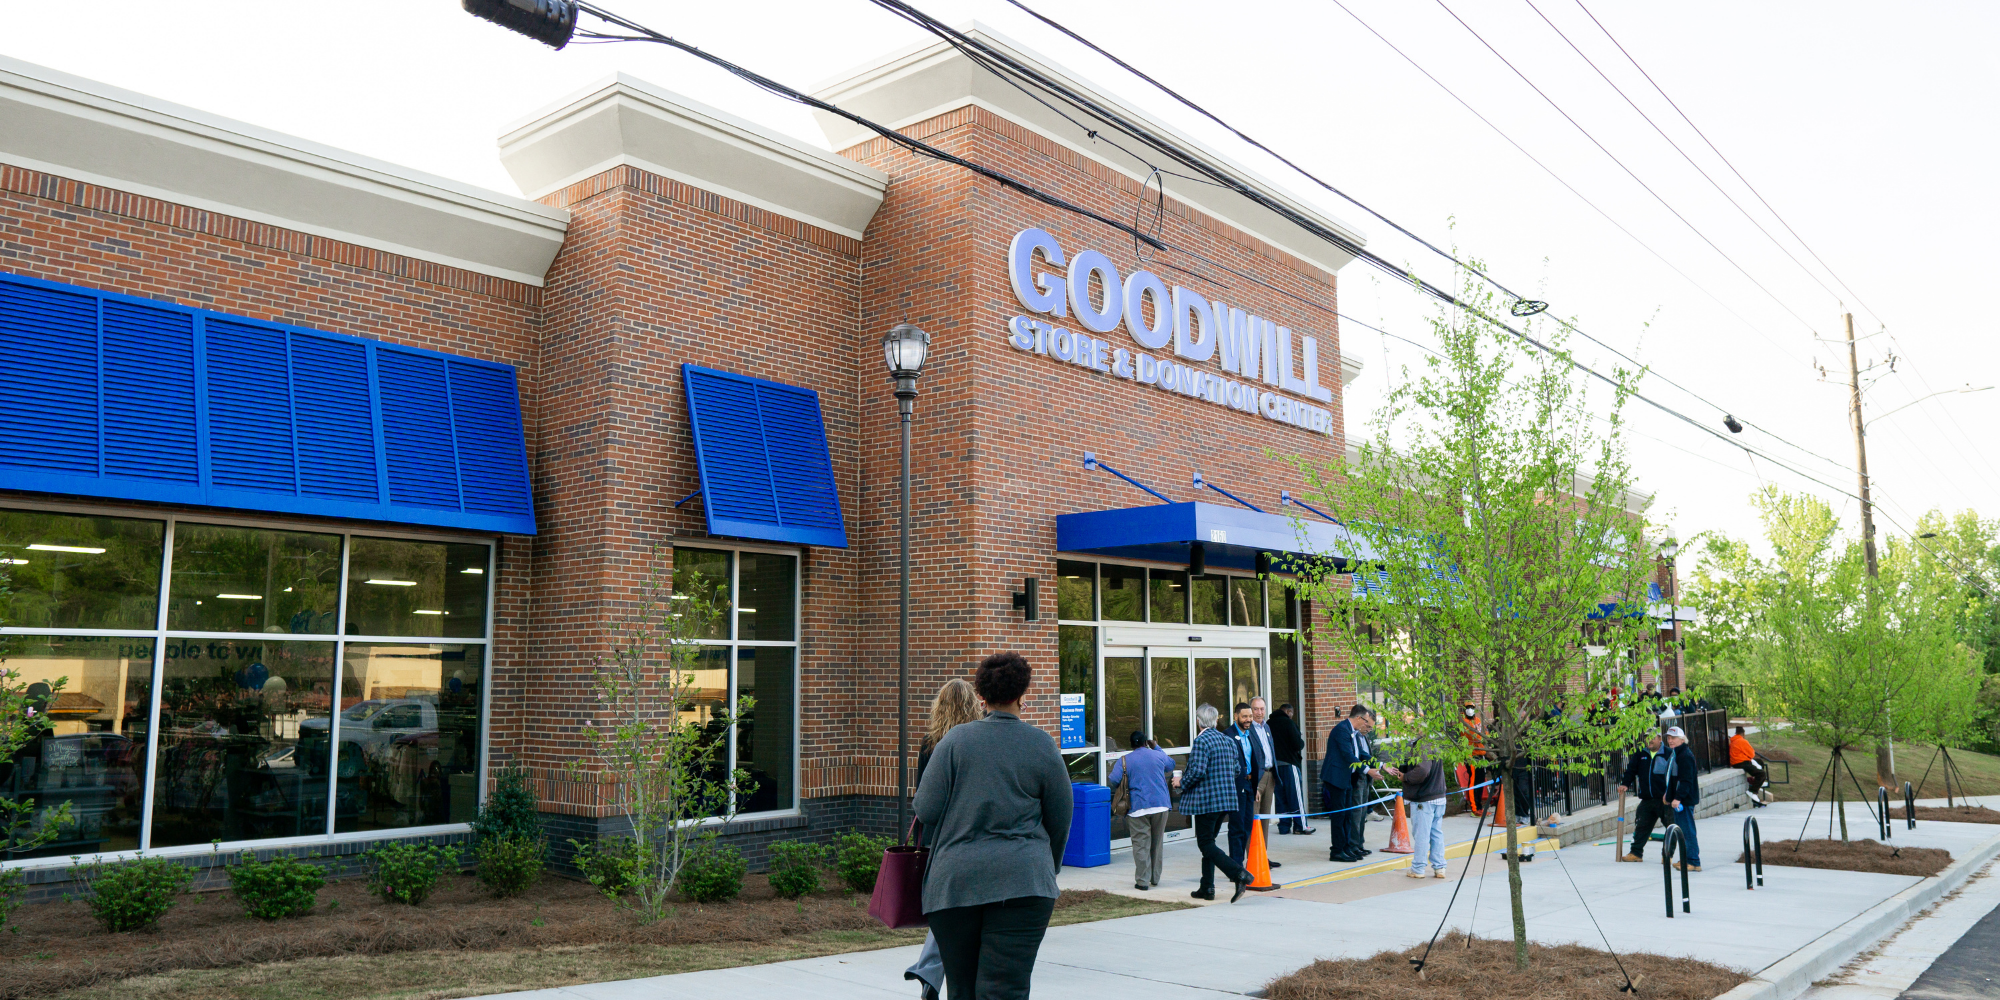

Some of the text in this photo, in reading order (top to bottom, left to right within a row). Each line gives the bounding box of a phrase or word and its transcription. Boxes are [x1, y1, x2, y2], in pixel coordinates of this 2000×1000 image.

[1009, 228, 1333, 404] GOODWILL
[1009, 315, 1334, 436] STORE & DONATION CENTER
[140, 600, 179, 610] Woen
[118, 640, 201, 660] peple
[207, 643, 230, 660] to
